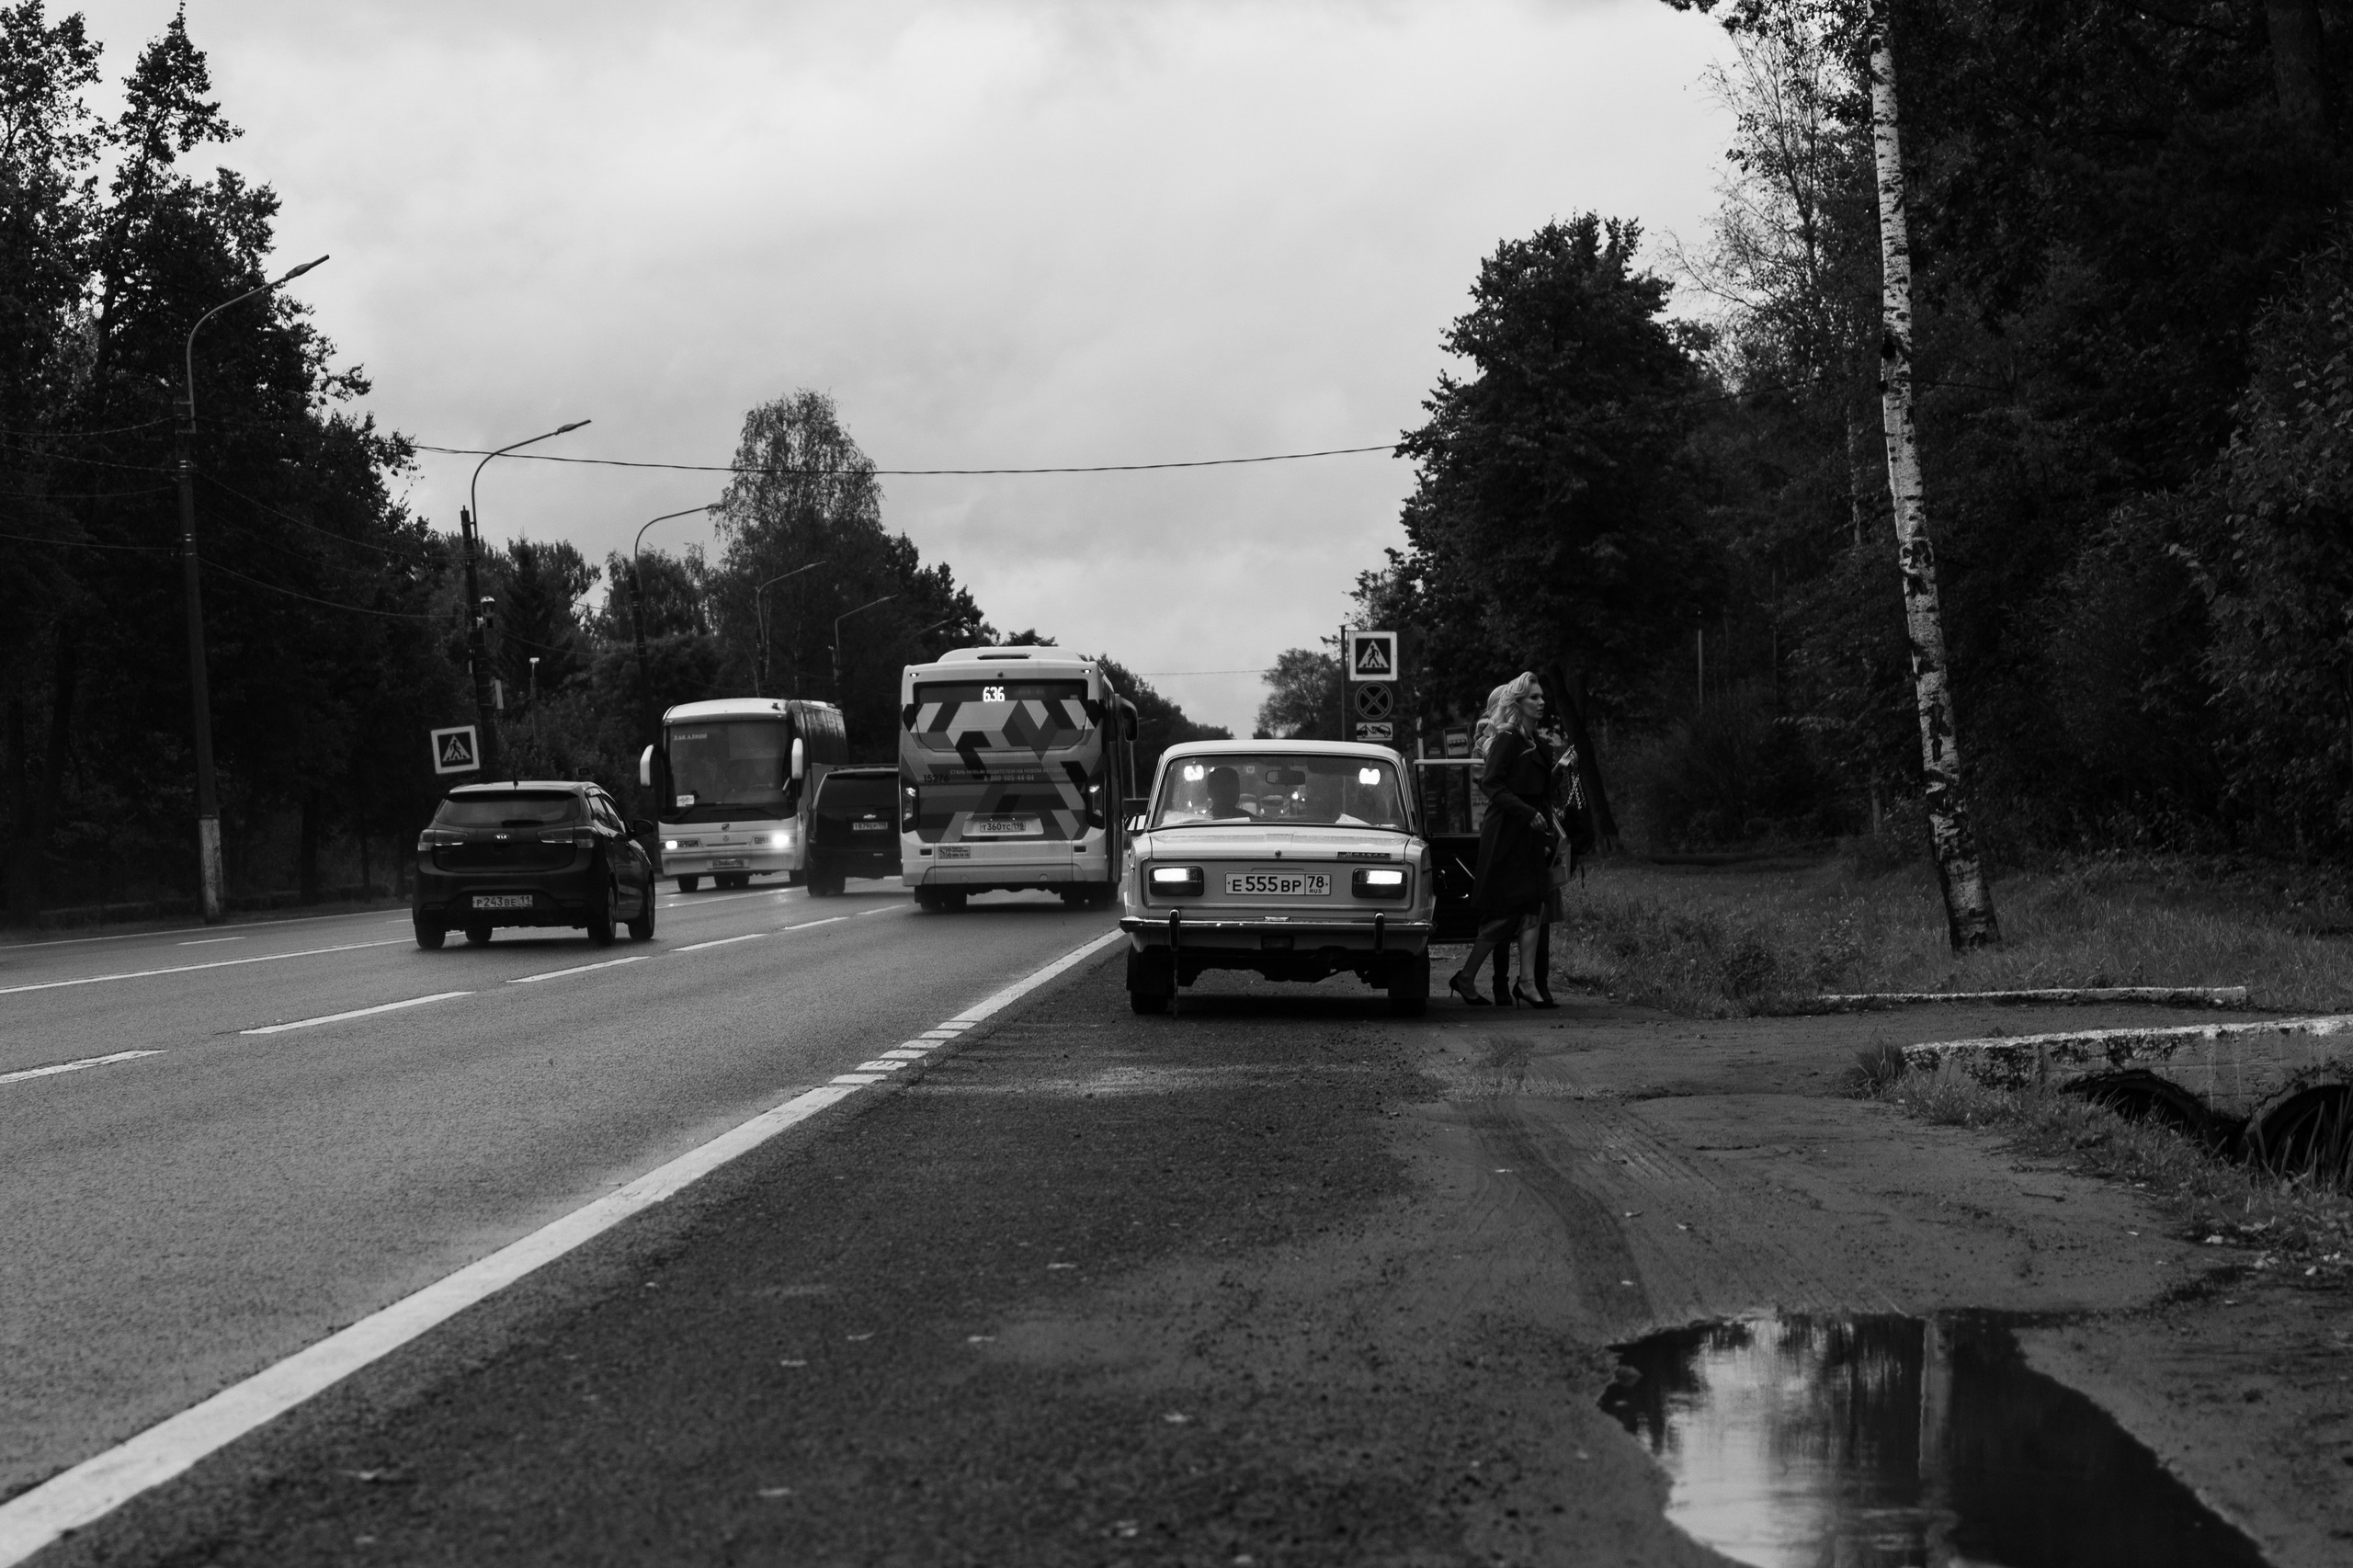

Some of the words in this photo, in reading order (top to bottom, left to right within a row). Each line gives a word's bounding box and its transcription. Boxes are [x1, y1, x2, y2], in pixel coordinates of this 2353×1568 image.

[983, 686, 1006, 702] 636
[924, 774, 949, 783] 15276
[1307, 876, 1324, 888] 78
